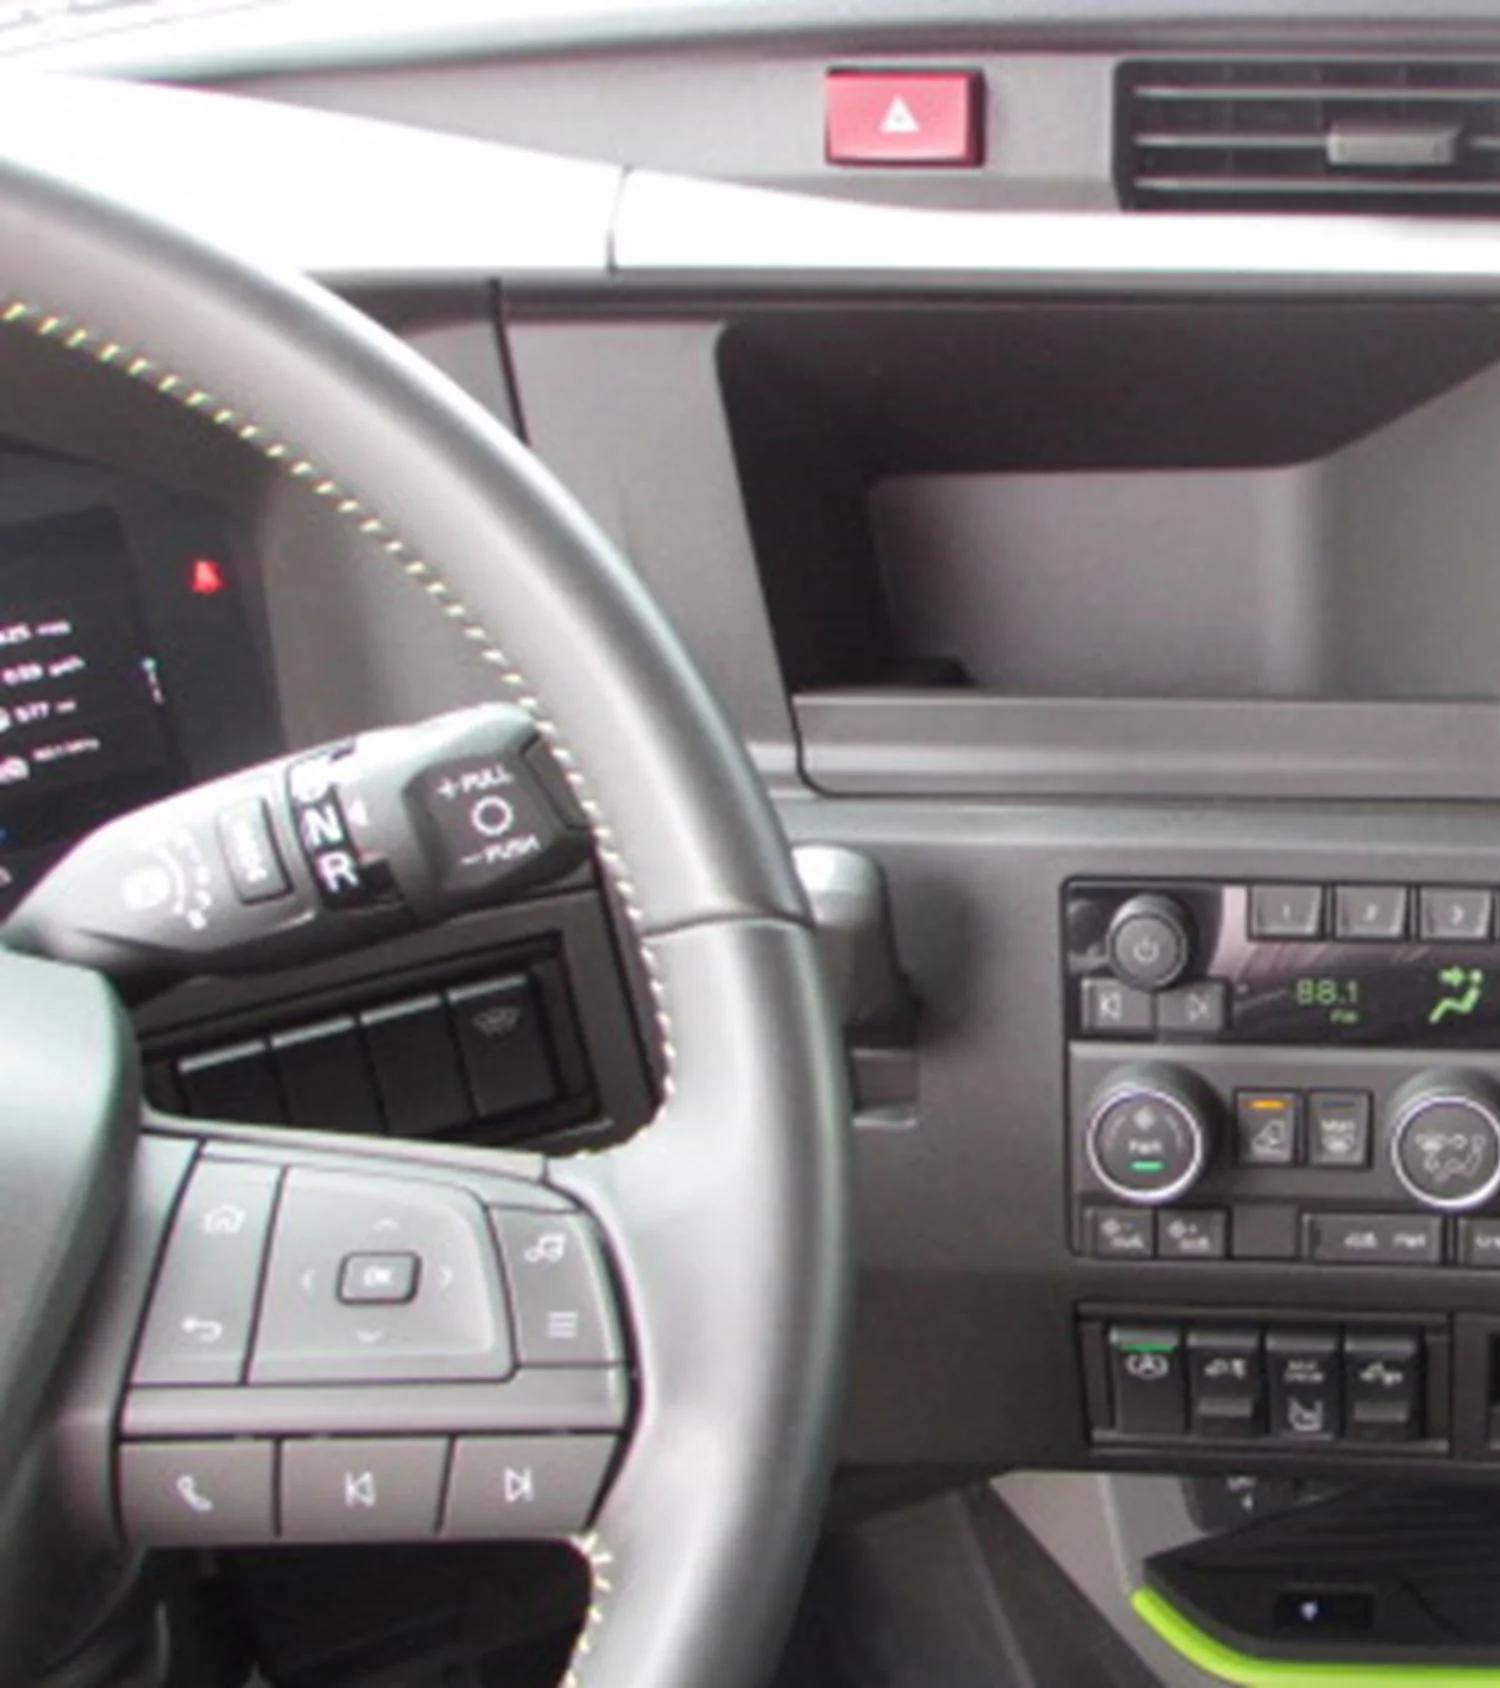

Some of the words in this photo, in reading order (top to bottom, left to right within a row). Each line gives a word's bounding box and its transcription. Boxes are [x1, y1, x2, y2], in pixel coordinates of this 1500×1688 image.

[302, 802, 345, 849] N
[484, 833, 541, 865] PUSH
[317, 850, 360, 894] R
[1297, 978, 1359, 1007] 88.1
